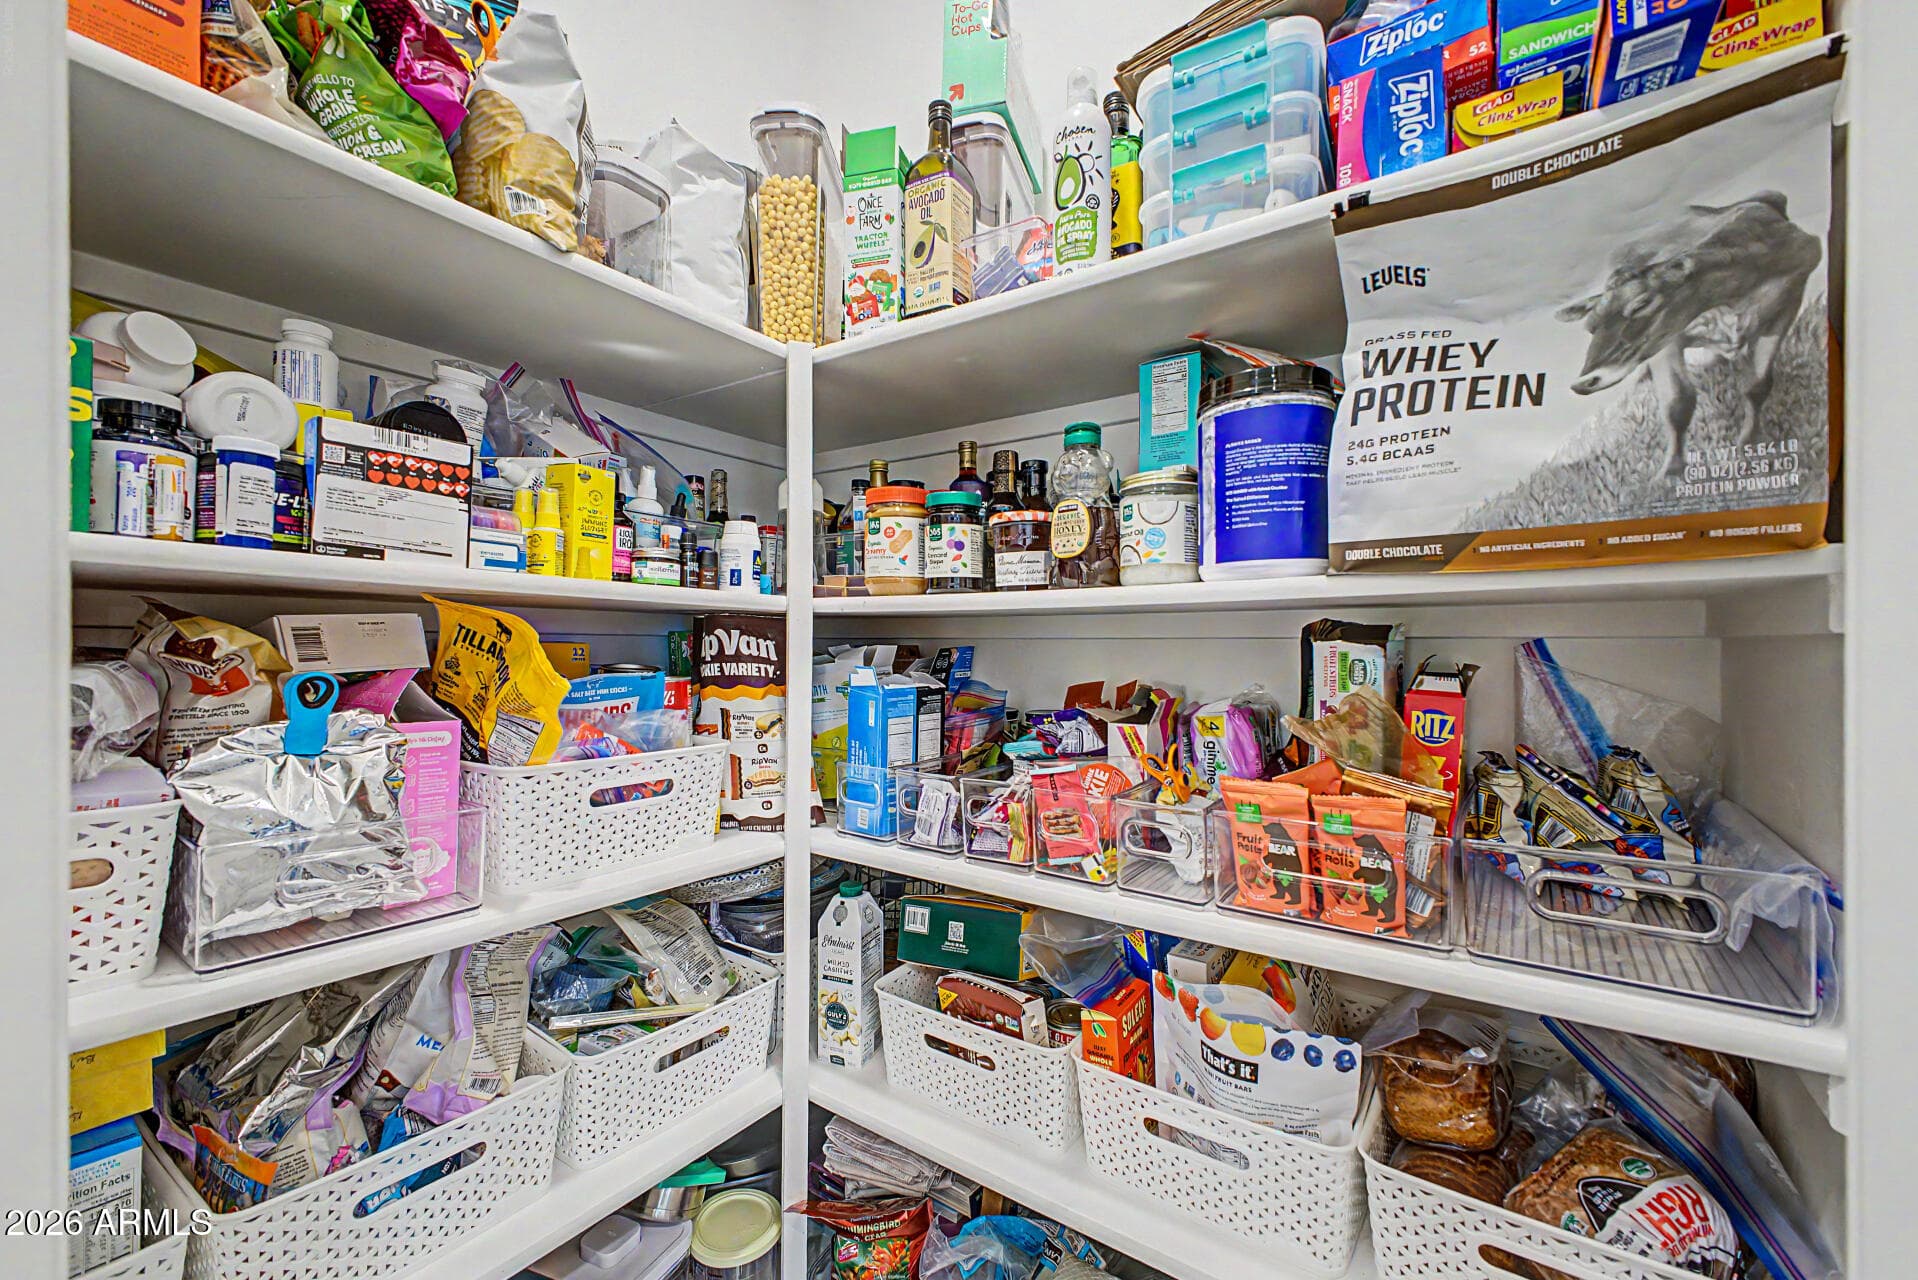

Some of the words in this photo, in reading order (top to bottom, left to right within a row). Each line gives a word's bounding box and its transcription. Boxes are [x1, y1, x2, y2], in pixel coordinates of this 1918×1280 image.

[951, 13, 973, 26] Hot
[951, 23, 982, 37] Cups
[1366, 12, 1446, 58] Ziploc
[1709, 15, 1756, 45] GLAD
[1711, 35, 1762, 59] Cling
[1762, 16, 1816, 43] Wrap
[1469, 41, 1488, 57] 52
[1508, 21, 1597, 60] SANDWICH
[339, 75, 355, 88] TO
[306, 88, 355, 114] WHOLE
[1342, 81, 1354, 126] SNACK
[1475, 92, 1514, 115] GLAD
[319, 103, 359, 127] GRAIN
[1390, 76, 1430, 157] Ziploc
[1478, 109, 1514, 127] Cling
[1517, 96, 1558, 115] Wrap
[367, 125, 383, 141] &
[354, 139, 407, 160] CREAM
[1491, 159, 1542, 190] DOUBLE
[1543, 135, 1623, 175] CHOCOLATE
[907, 179, 947, 198] ORGANIC
[908, 188, 945, 210] AVOCADO
[920, 208, 933, 220] OIL
[1361, 264, 1428, 295] LEVELS
[1365, 331, 1417, 347] GRASS
[1420, 329, 1452, 340] FED
[1361, 338, 1499, 379] WHEY
[1350, 372, 1546, 427] PROTEIN
[1348, 438, 1375, 451] 24G
[1379, 425, 1452, 447] PROTEIN
[1346, 452, 1378, 466] 5.4G
[1382, 444, 1435, 462] BCAAS
[1744, 442, 1776, 457] 5.64
[1676, 481, 1734, 498] PROTEIN
[1737, 473, 1800, 492] POWDER
[1621, 534, 1651, 543] ADDED
[1760, 523, 1802, 535] FILLERS
[619, 538, 633, 549] IRO
[1345, 548, 1382, 561] DOUBLE
[1382, 544, 1444, 559] CHOCOLATE
[1491, 543, 1532, 552] ARTIFICIAL
[1533, 539, 1585, 550] INGREDIENTS
[572, 647, 586, 657] 12
[722, 662, 775, 677] VARIETY
[1410, 711, 1456, 740] RITZ
[1202, 740, 1216, 785] gimme
[1236, 831, 1263, 844] Fruit
[1237, 841, 1262, 854] Rolls
[1268, 843, 1296, 857] BEAR
[1324, 843, 1354, 858] Fruit
[1325, 855, 1355, 868] Rolls
[1360, 856, 1393, 872] BEAR
[1122, 994, 1146, 1038] SOLELY
[1089, 1055, 1113, 1066] WHOLE
[1201, 1045, 1236, 1075] That's
[1214, 1075, 1234, 1087] FRUIT
[1234, 1083, 1252, 1093] BARS
[69, 1184, 98, 1201] ition
[100, 1172, 131, 1191] Facts
